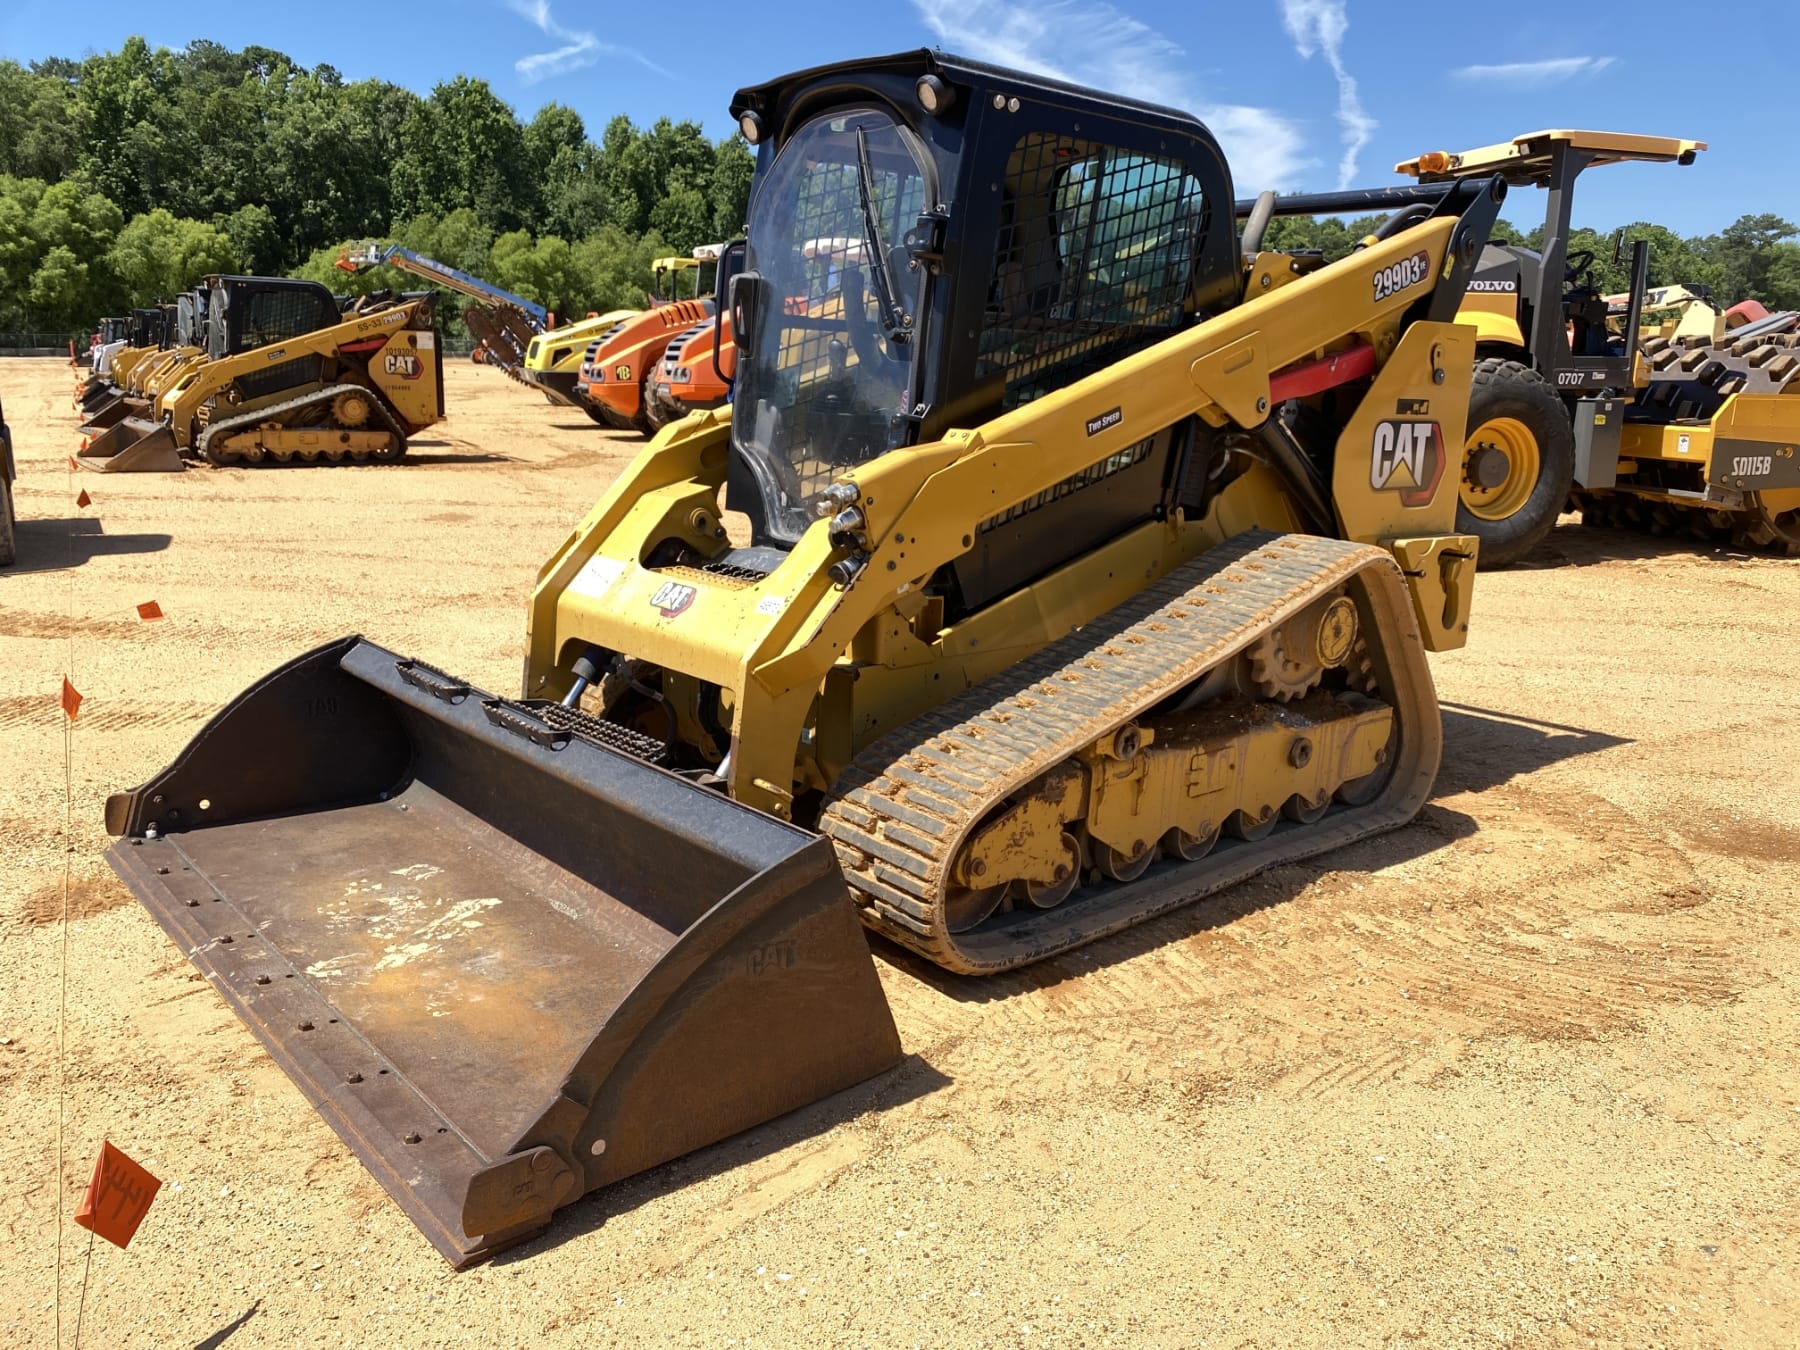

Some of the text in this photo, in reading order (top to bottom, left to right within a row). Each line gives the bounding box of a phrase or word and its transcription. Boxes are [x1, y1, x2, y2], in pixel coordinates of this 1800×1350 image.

[1373, 255, 1420, 301] 299D3
[384, 354, 415, 376] CAT
[1557, 373, 1585, 385] 0707
[1370, 422, 1433, 489] CAT
[1731, 456, 1772, 476] SD115B
[649, 581, 697, 612] CAT
